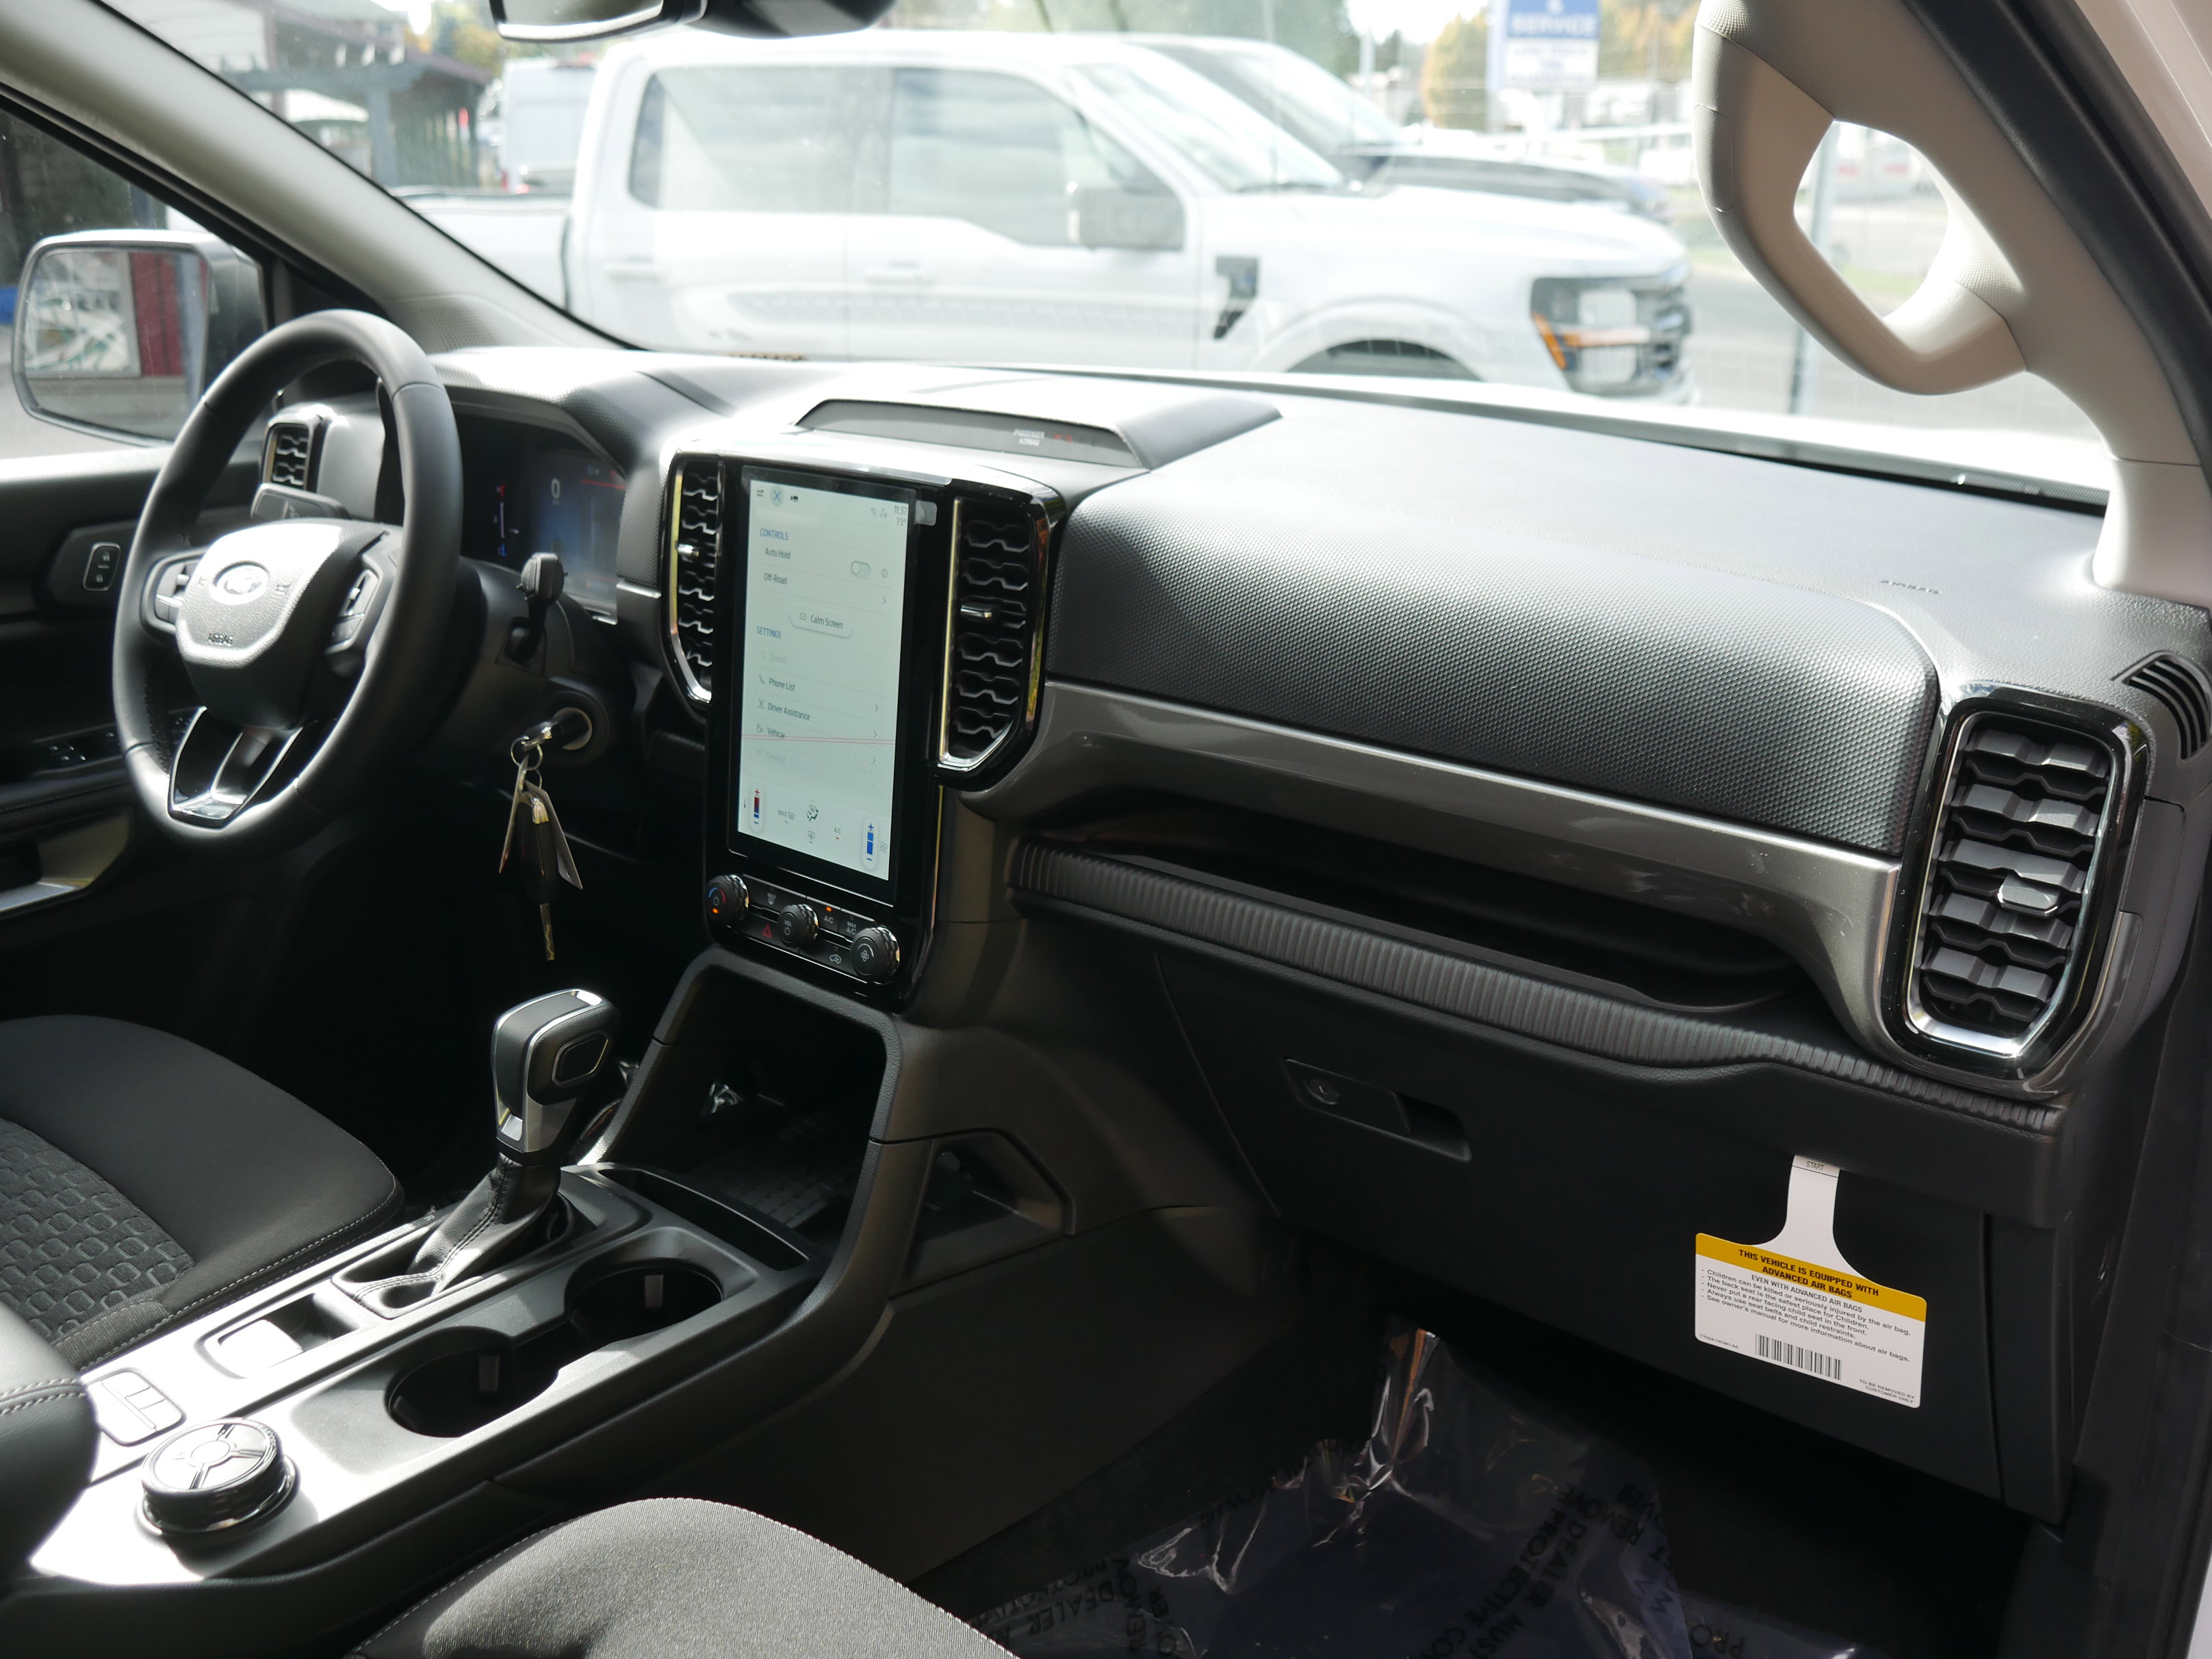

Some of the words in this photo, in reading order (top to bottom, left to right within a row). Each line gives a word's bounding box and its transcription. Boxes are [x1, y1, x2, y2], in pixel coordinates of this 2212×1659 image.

[895, 505, 908, 515] 11:37
[760, 528, 789, 541] CONTROLS
[765, 548, 777, 557] Auto
[778, 550, 791, 560] Hold
[764, 572, 787, 585] Off-Road
[810, 615, 824, 625] Calm
[825, 617, 843, 629] Screen
[756, 626, 782, 639] SETTINGS
[769, 678, 785, 689] Phone
[786, 682, 795, 691] List
[768, 702, 783, 713] Driver
[784, 707, 810, 721] Assistance
[767, 727, 785, 738] Vehicle
[823, 916, 834, 924] A/C
[846, 927, 857, 936] A/C
[1806, 1161, 1824, 1170] START
[1738, 1249, 1758, 1261] THIS
[1760, 1255, 1796, 1272] VEHICLE
[1799, 1267, 1807, 1275] IS
[1810, 1270, 1853, 1288] EQUIPPED
[1855, 1283, 1879, 1296] WITH
[1762, 1266, 1808, 1285] ADVANCED
[1811, 1281, 1826, 1291] AIR
[1829, 1285, 1852, 1298] BAGS
[1751, 1274, 1769, 1285] EVEN
[1771, 1281, 1788, 1291] WITH
[1790, 1287, 1827, 1302] ADVANCED
[1829, 1298, 1841, 1307] AIR
[1843, 1302, 1862, 1313] BAGS
[1707, 1269, 1737, 1283] Children
[1764, 1287, 1783, 1296] killed
[1795, 1296, 1828, 1311] seriously
[1830, 1306, 1855, 1319] injured
[1857, 1315, 1866, 1323] by
[1868, 1318, 1881, 1326] the
[1894, 1326, 1911, 1336] bag.
[1707, 1275, 1721, 1284] The
[1722, 1281, 1738, 1289] back
[1740, 1287, 1756, 1295] seat
[1765, 1293, 1777, 1301] the
[1779, 1298, 1801, 1308] safest
[1802, 1304, 1821, 1314] place
[1836, 1314, 1869, 1330] Children.
[1707, 1282, 1727, 1292] Never
[1764, 1298, 1786, 1311] facing
[1788, 1307, 1805, 1317] child
[1808, 1313, 1823, 1322] seat
[1834, 1321, 1845, 1329] the
[1847, 1325, 1867, 1336] front.
[1707, 1289, 1732, 1300] Always
[1749, 1302, 1763, 1310] seat
[1765, 1306, 1782, 1316] belts
[1784, 1311, 1797, 1321] and
[1799, 1317, 1817, 1327] child
[1819, 1324, 1856, 1339] restraints.
[1707, 1294, 1720, 1303] See
[1722, 1300, 1749, 1312] owner's
[1751, 1309, 1777, 1321] manual
[1790, 1321, 1809, 1331] more
[1810, 1326, 1853, 1345] information
[1854, 1341, 1876, 1352] about
[1890, 1351, 1910, 1362] bags.
[1866, 1386, 1898, 1399] CUSTOMER
[1877, 1384, 1905, 1397] REMOVED
[1528, 1521, 1588, 1608] DEALER
[1028, 1580, 1116, 1636] DEALER
